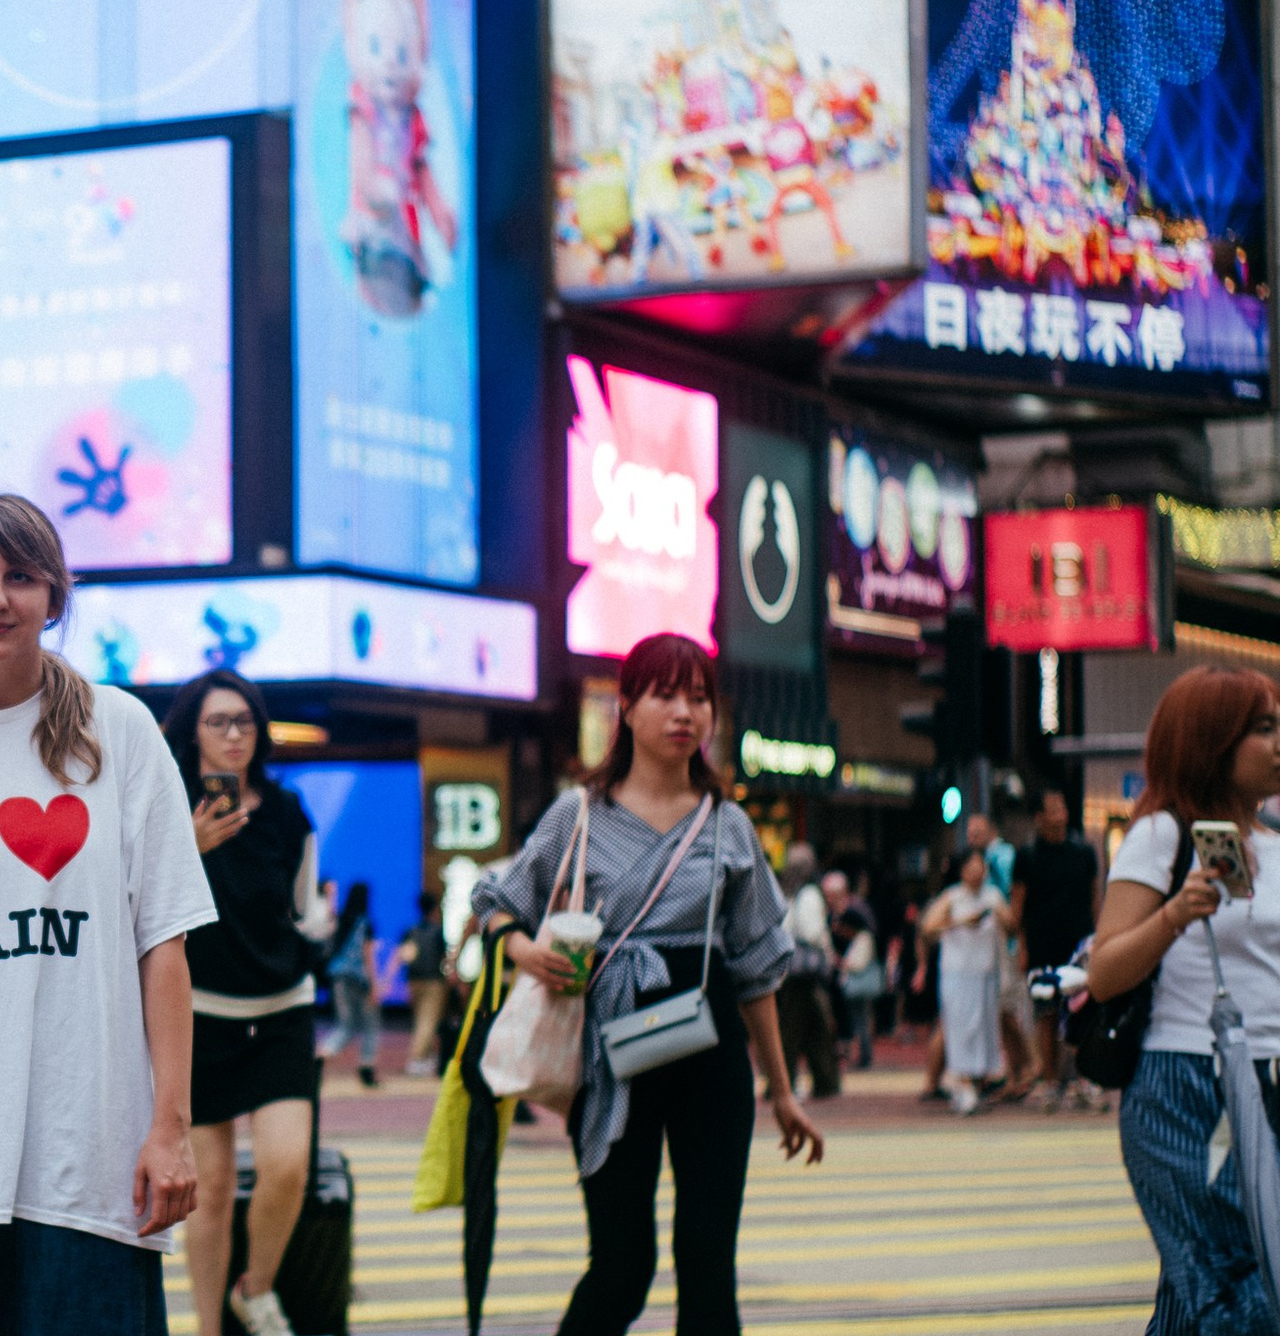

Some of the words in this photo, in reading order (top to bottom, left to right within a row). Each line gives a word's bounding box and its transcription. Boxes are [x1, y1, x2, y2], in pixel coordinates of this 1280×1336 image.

[923, 280, 1187, 373] 日夜玩不停
